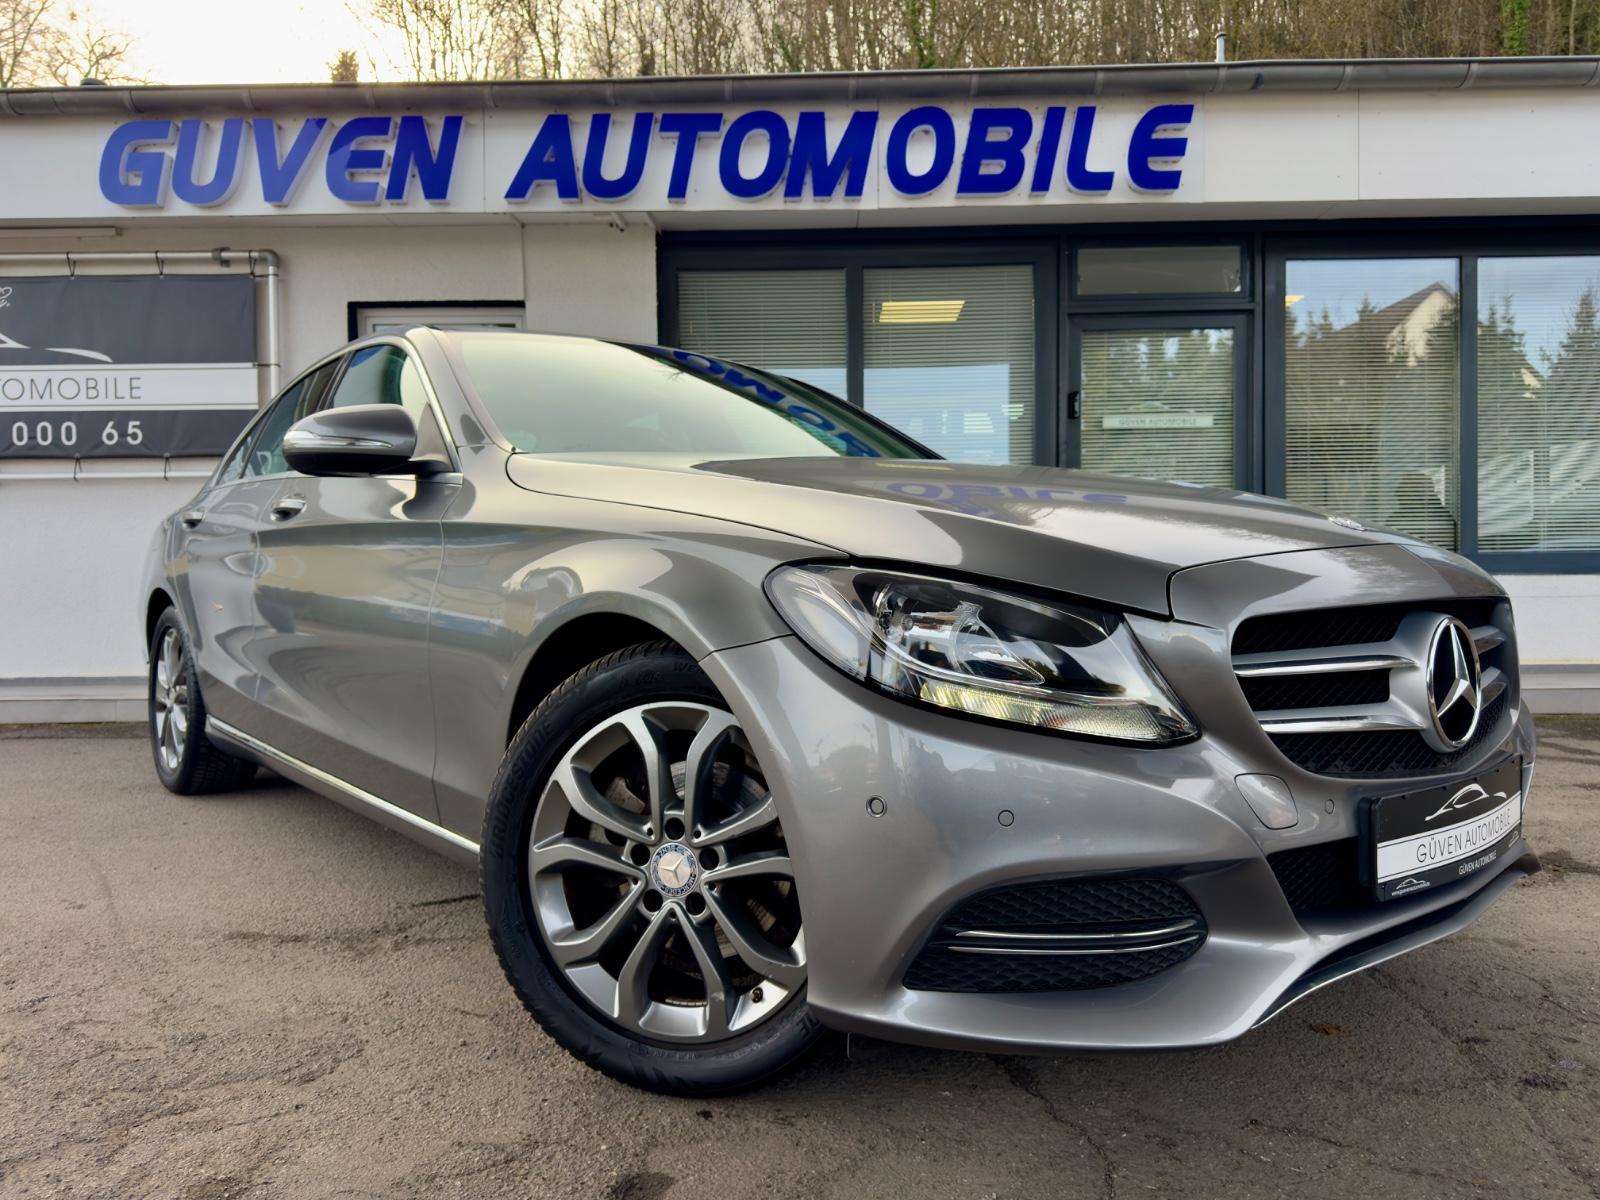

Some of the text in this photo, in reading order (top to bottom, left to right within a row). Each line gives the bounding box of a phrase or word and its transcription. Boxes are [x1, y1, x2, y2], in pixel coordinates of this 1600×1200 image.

[505, 103, 1195, 203] AUTOMOBILE
[0, 377, 142, 400] OMOBILE
[12, 420, 143, 446] 000 65
[1416, 807, 1512, 863] GÜVEN AUTOMOBILE
